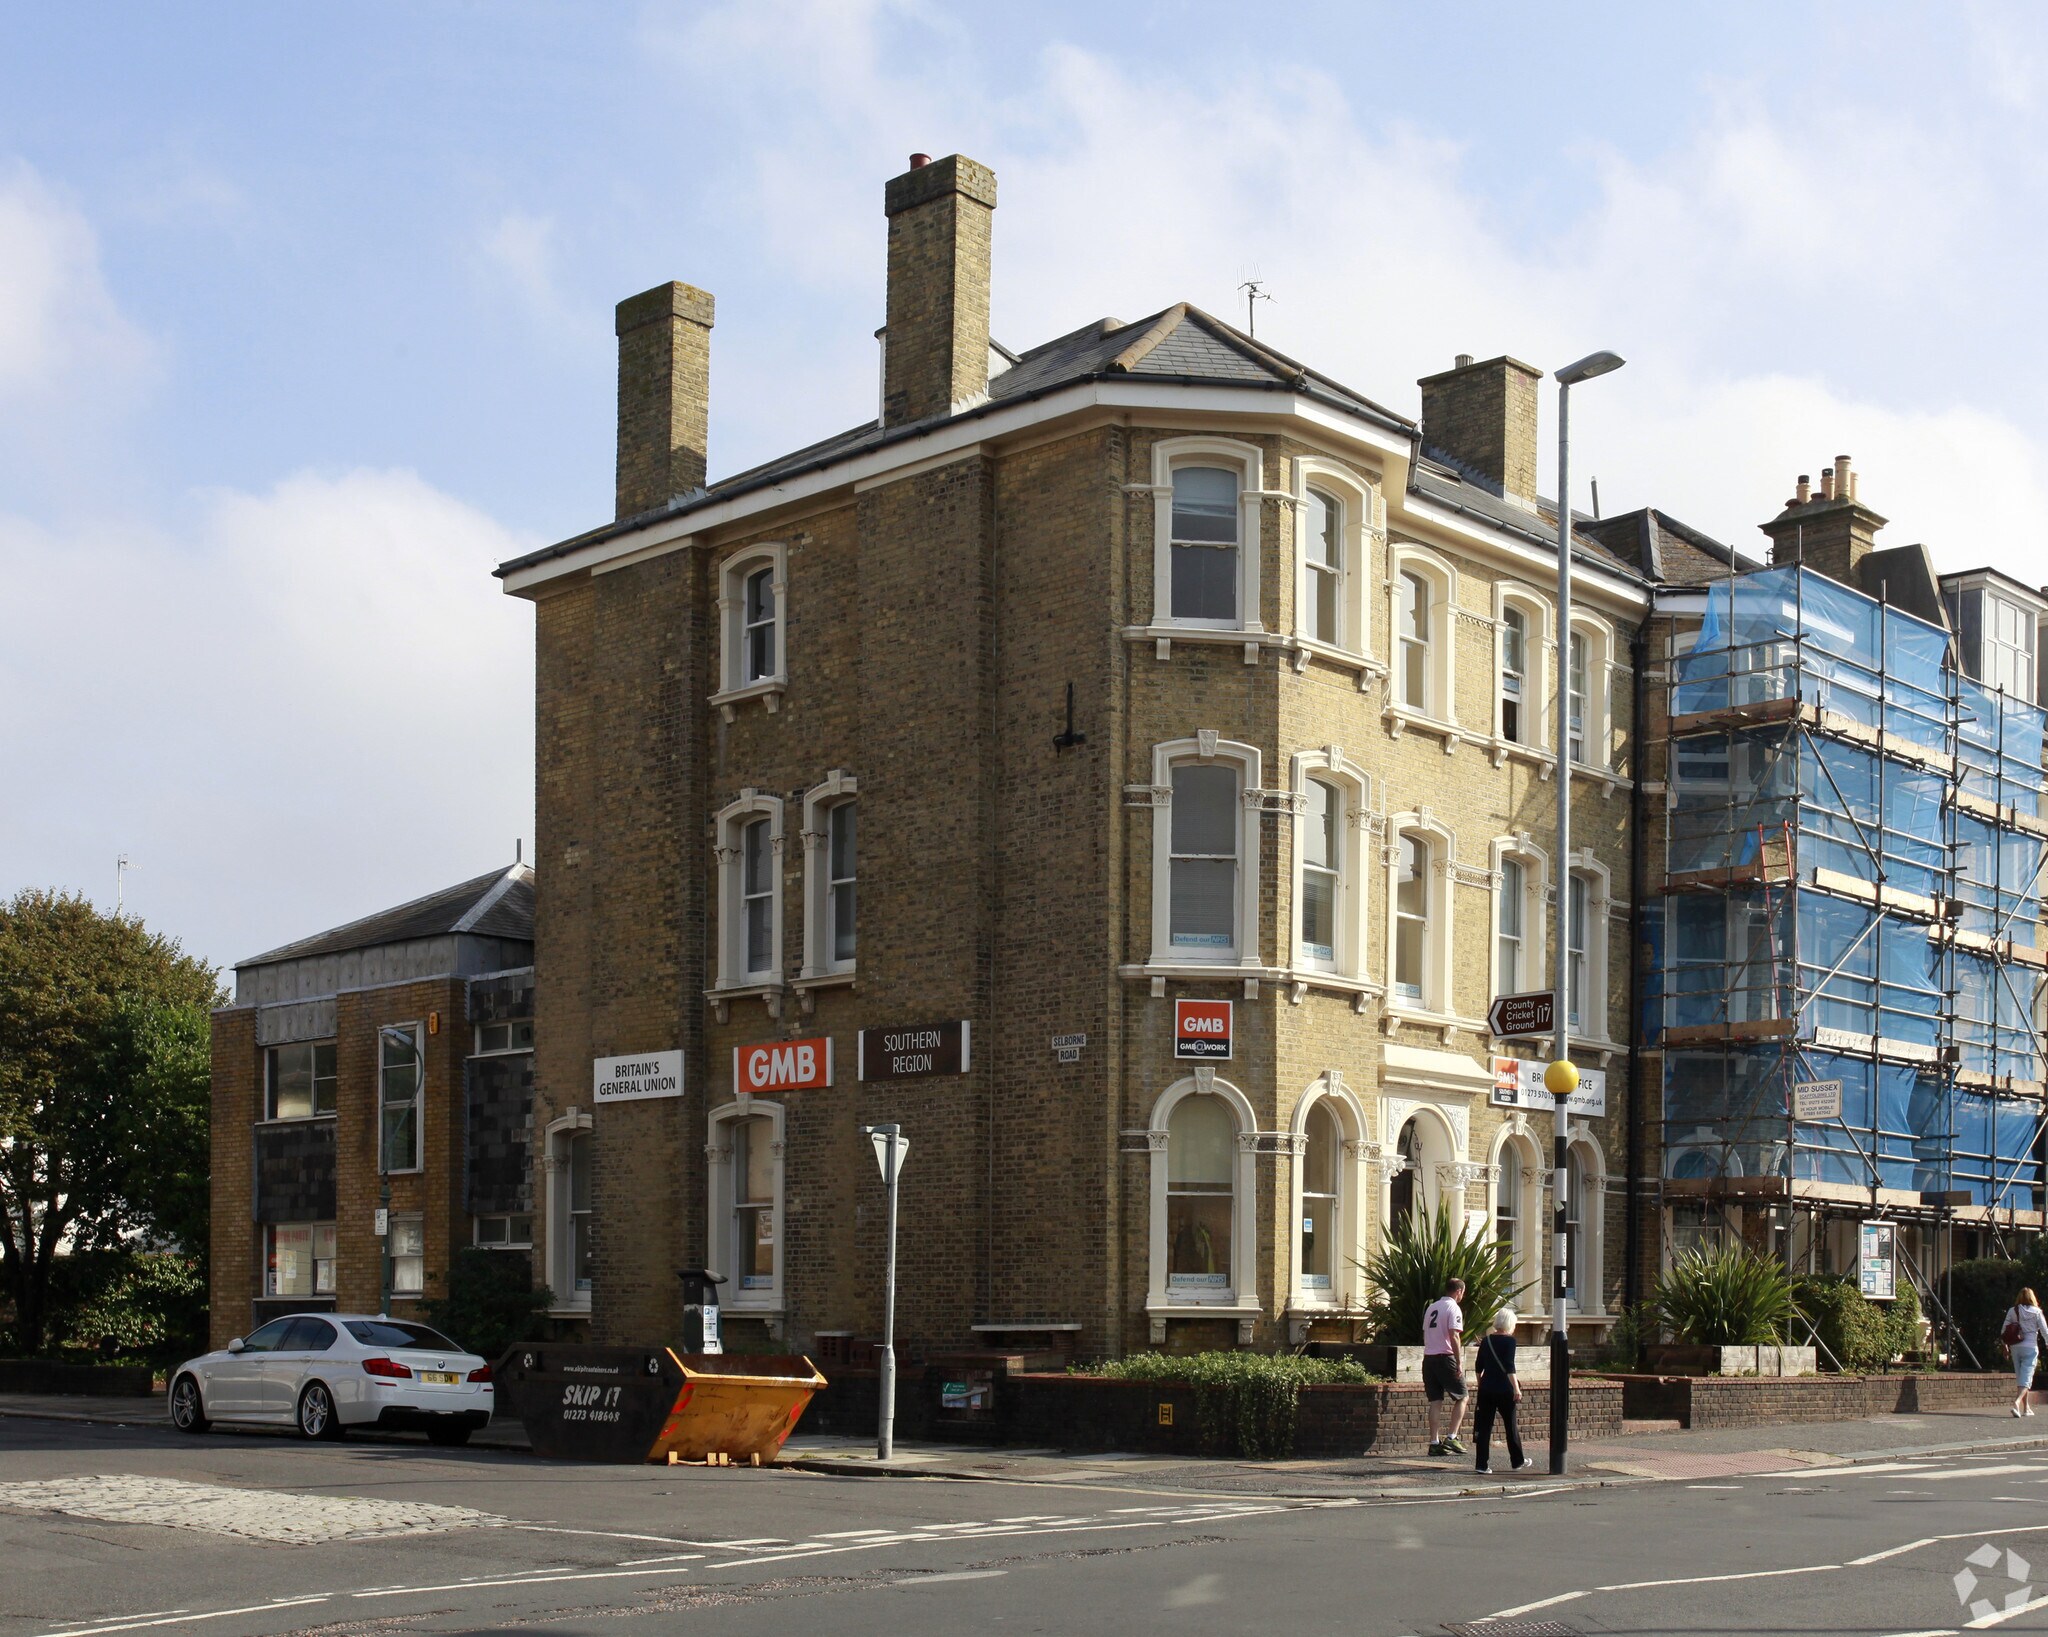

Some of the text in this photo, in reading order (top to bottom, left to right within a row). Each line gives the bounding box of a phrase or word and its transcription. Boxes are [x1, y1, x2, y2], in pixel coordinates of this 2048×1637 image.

[1506, 1000, 1535, 1010] County
[1506, 1010, 1535, 1021] Cricket
[1183, 1016, 1224, 1032] GMB
[1506, 1020, 1535, 1031] Ground
[884, 1030, 941, 1052] SOUTHERN
[1053, 1035, 1085, 1047] SELBORNE
[1060, 1049, 1078, 1060] ROAD
[615, 1061, 660, 1078] BRITAIN'S
[748, 1045, 816, 1087] GMB
[892, 1054, 932, 1074] REGION
[1497, 1070, 1516, 1084] GMB
[1532, 1072, 1592, 1090] BRI FICE
[600, 1076, 676, 1096] GENERAL UNION
[1811, 1084, 1838, 1093] SUSSEX
[1521, 1088, 1537, 1098] 01273
[1537, 1090, 1556, 1100] 57012
[1208, 1275, 1225, 1283] NHS
[1429, 1310, 1438, 1328] 2
[562, 1384, 622, 1407] SKIP IT
[563, 1409, 587, 1420] 01273
